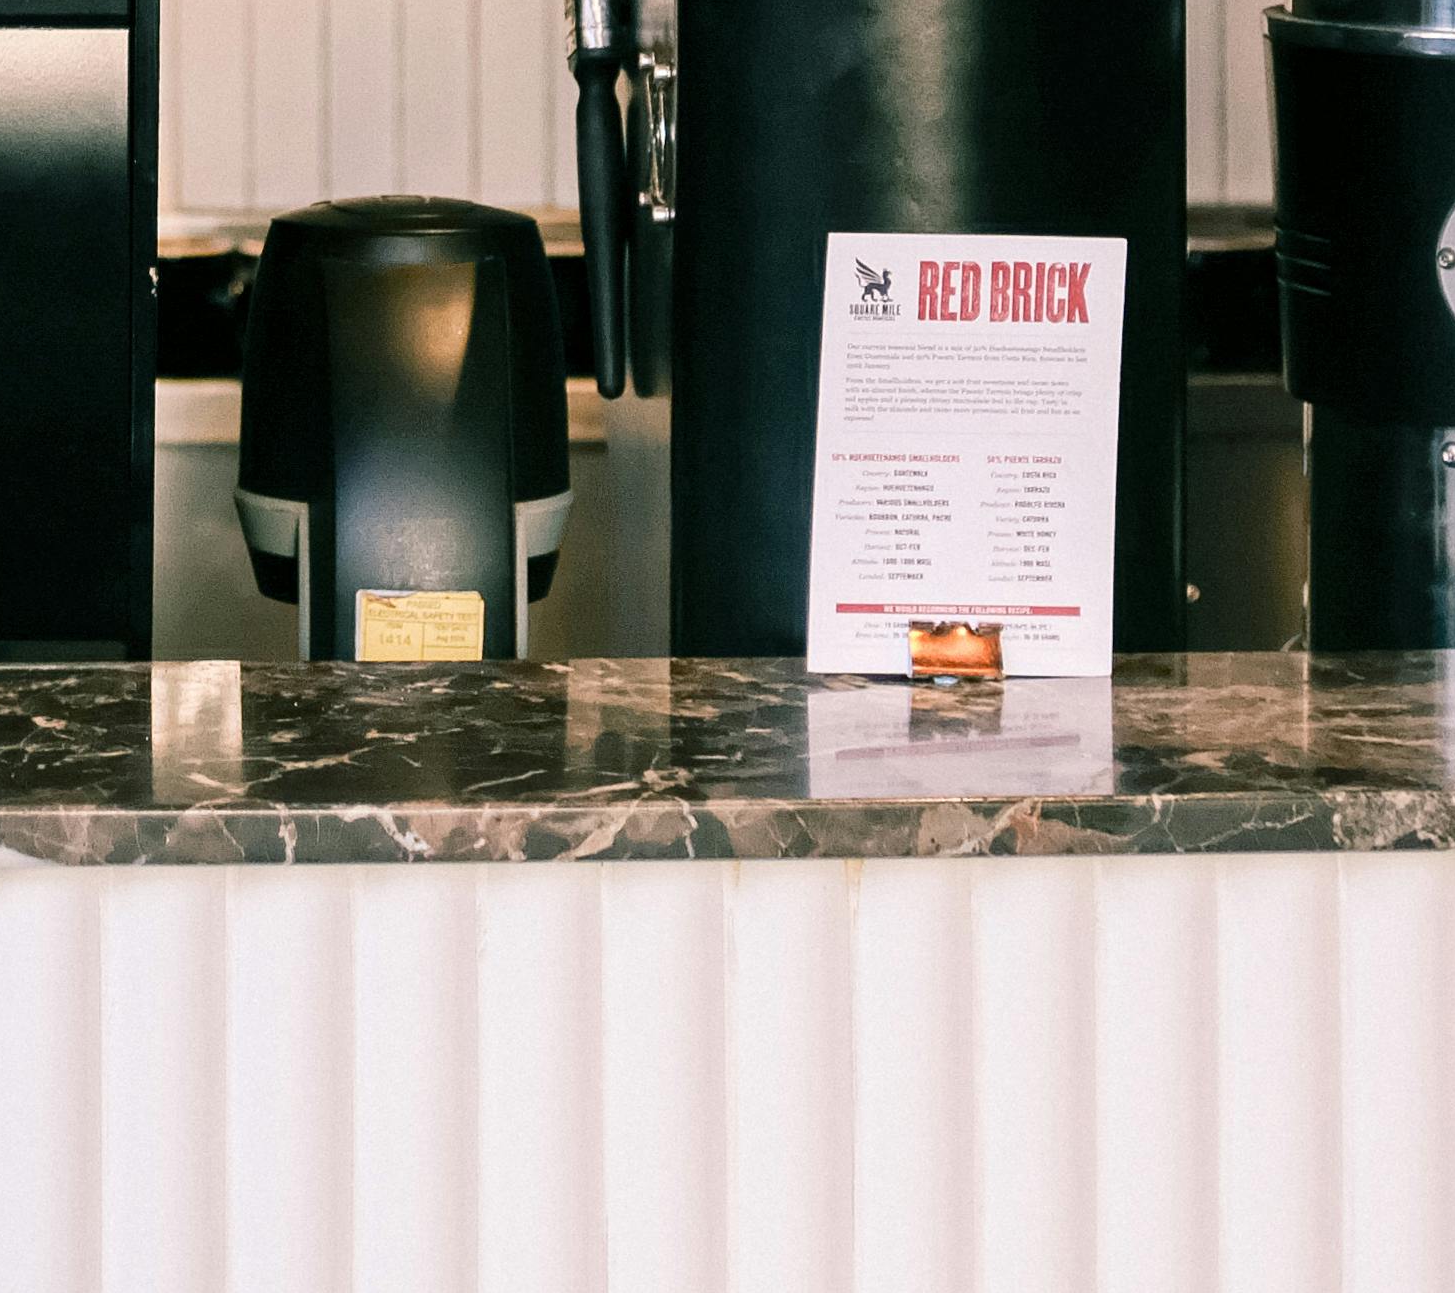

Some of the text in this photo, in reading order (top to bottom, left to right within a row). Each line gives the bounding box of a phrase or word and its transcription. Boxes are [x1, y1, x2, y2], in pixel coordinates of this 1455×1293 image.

[849, 303, 902, 316] SQUARE MILE
[917, 260, 1092, 324] RED BRICK
